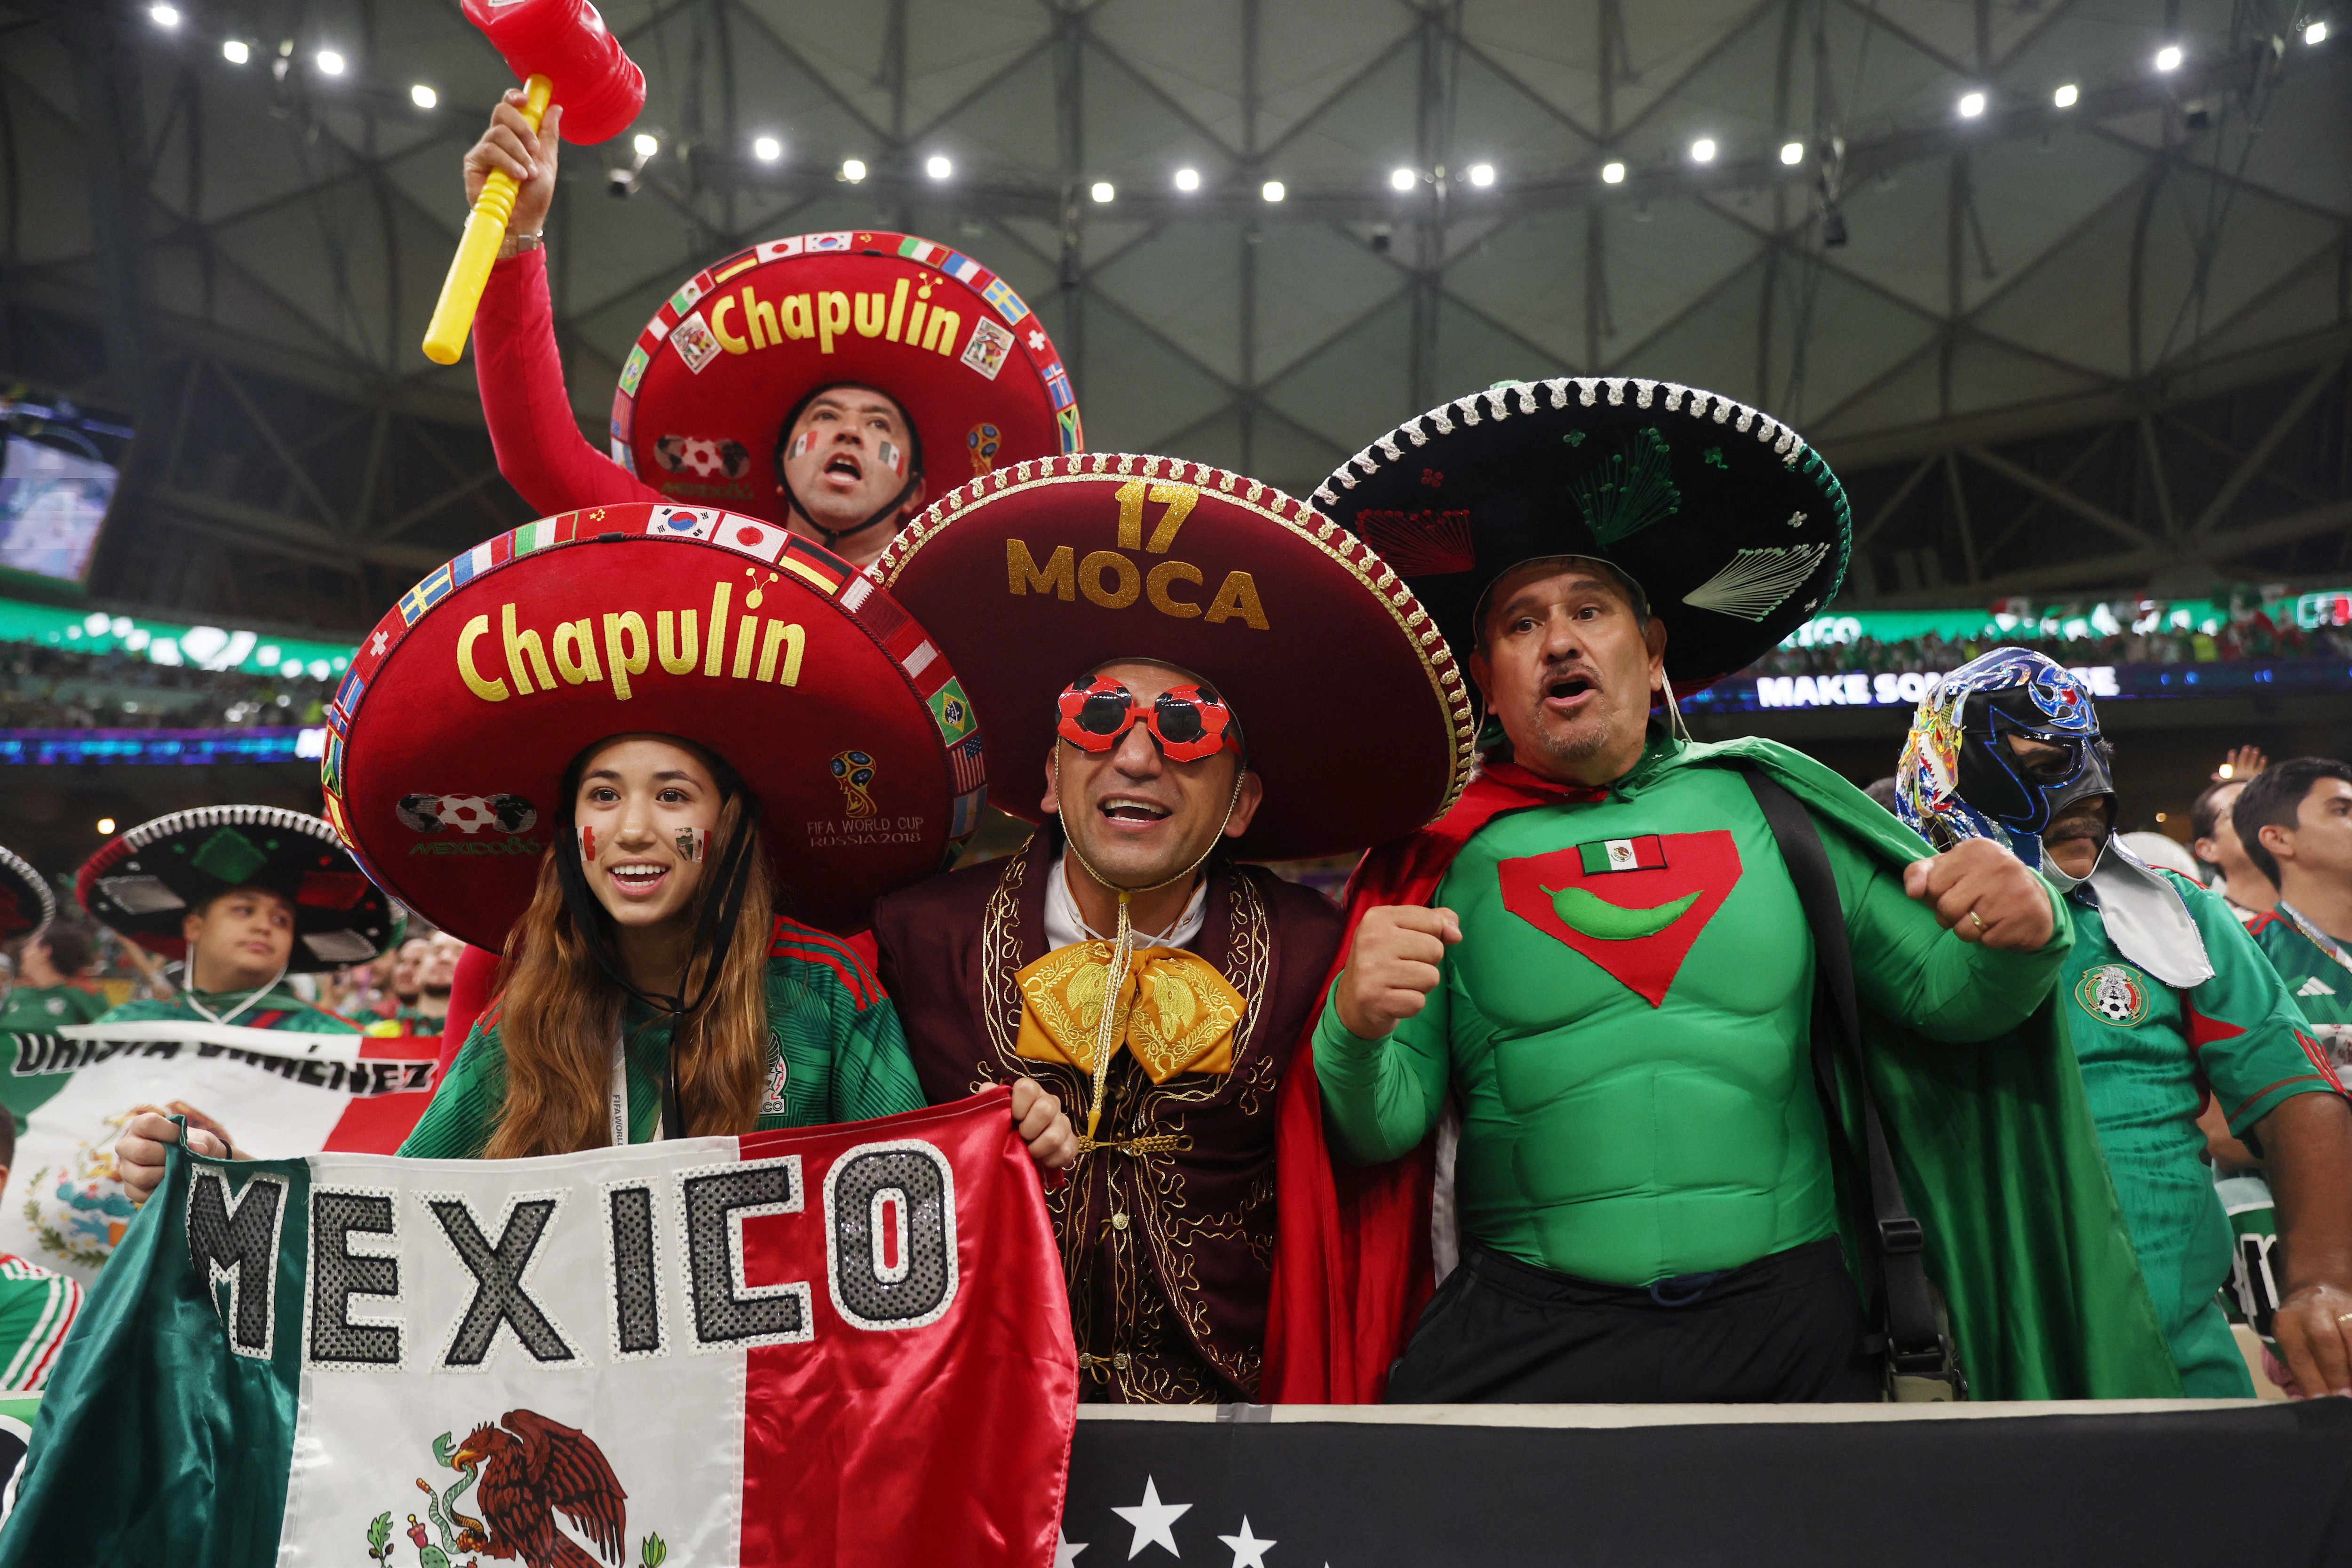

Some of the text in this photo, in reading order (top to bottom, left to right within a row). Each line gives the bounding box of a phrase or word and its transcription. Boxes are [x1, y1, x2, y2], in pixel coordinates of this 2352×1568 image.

[710, 273, 961, 356] Chapulin
[1114, 480, 1199, 553] 17
[1006, 538, 1270, 630] MOCA
[457, 567, 806, 702] Chapulin
[1756, 672, 1944, 707] MAKE SO
[807, 817, 924, 835] FIFA WORLD CUP
[810, 833, 921, 847] RUSSIA 2018
[612, 1094, 621, 1114] FIFA
[186, 1138, 960, 1372] MEXICO
